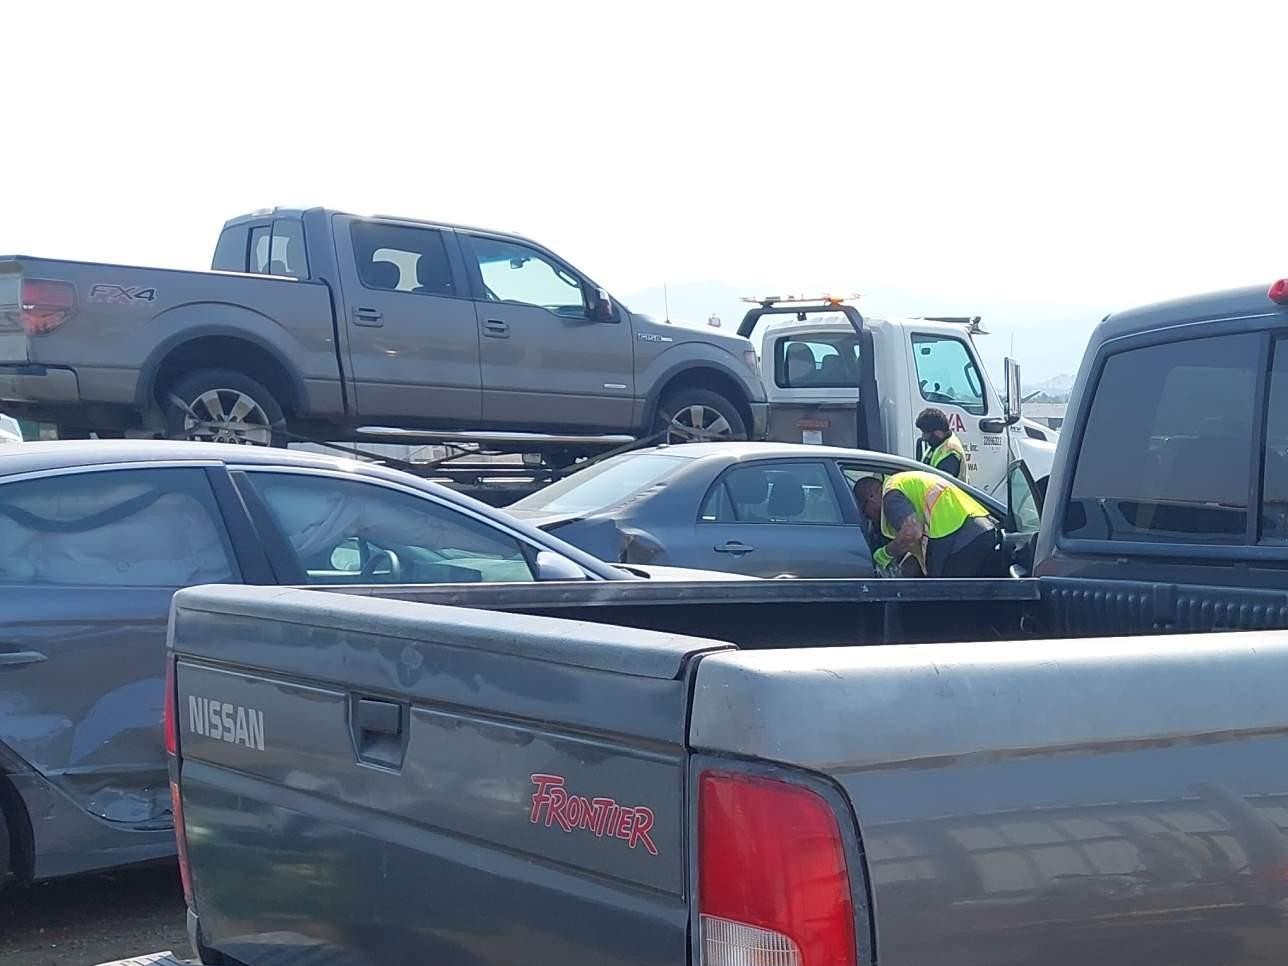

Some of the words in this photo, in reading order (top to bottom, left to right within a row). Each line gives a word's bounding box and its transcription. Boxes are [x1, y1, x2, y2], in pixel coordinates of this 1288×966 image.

[90, 284, 156, 302] FX4
[189, 695, 264, 751] NISSAN
[531, 774, 658, 855] FRONTIER
